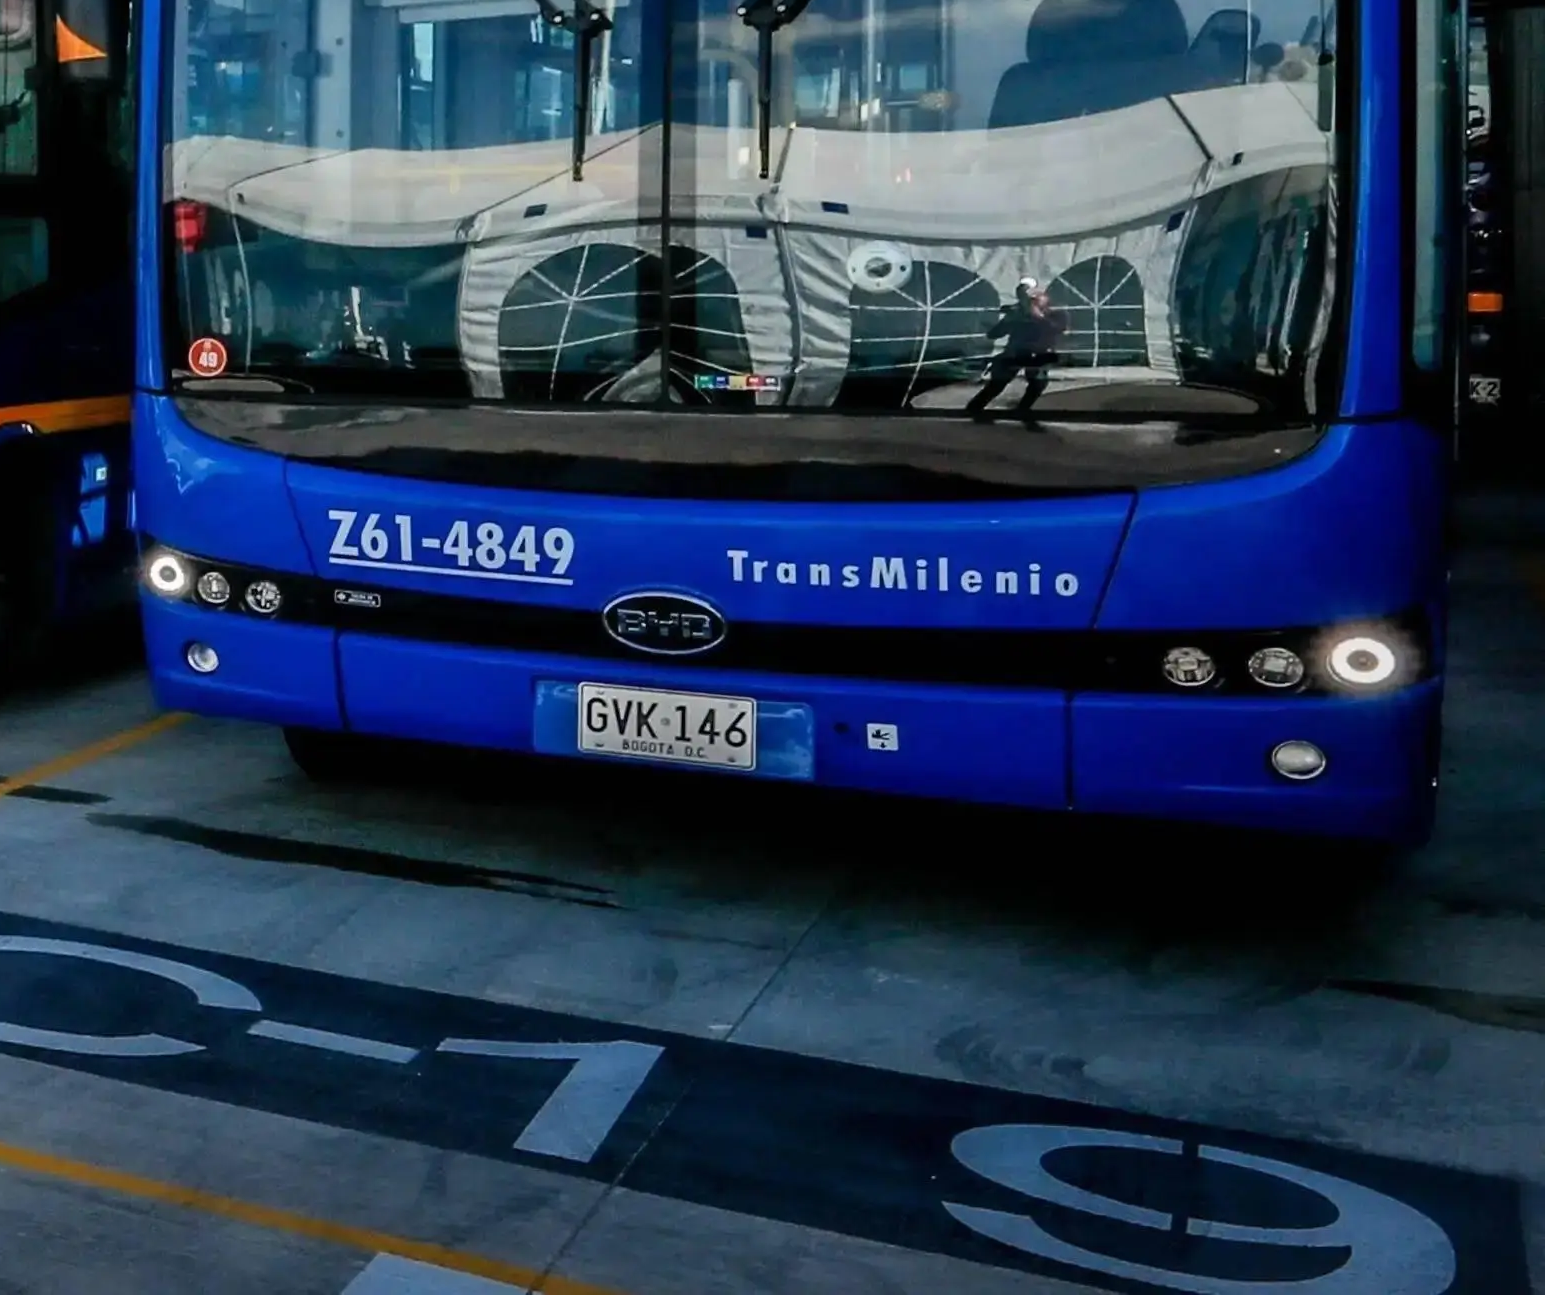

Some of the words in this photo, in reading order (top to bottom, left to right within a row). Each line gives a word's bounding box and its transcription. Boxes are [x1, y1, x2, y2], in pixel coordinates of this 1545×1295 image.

[327, 509, 576, 577] Z61-4849
[728, 550, 1081, 598] TransMilenio
[616, 608, 713, 640] BYD
[586, 697, 660, 740] GVK
[674, 705, 748, 748] 146
[622, 738, 675, 756] BOGOTA
